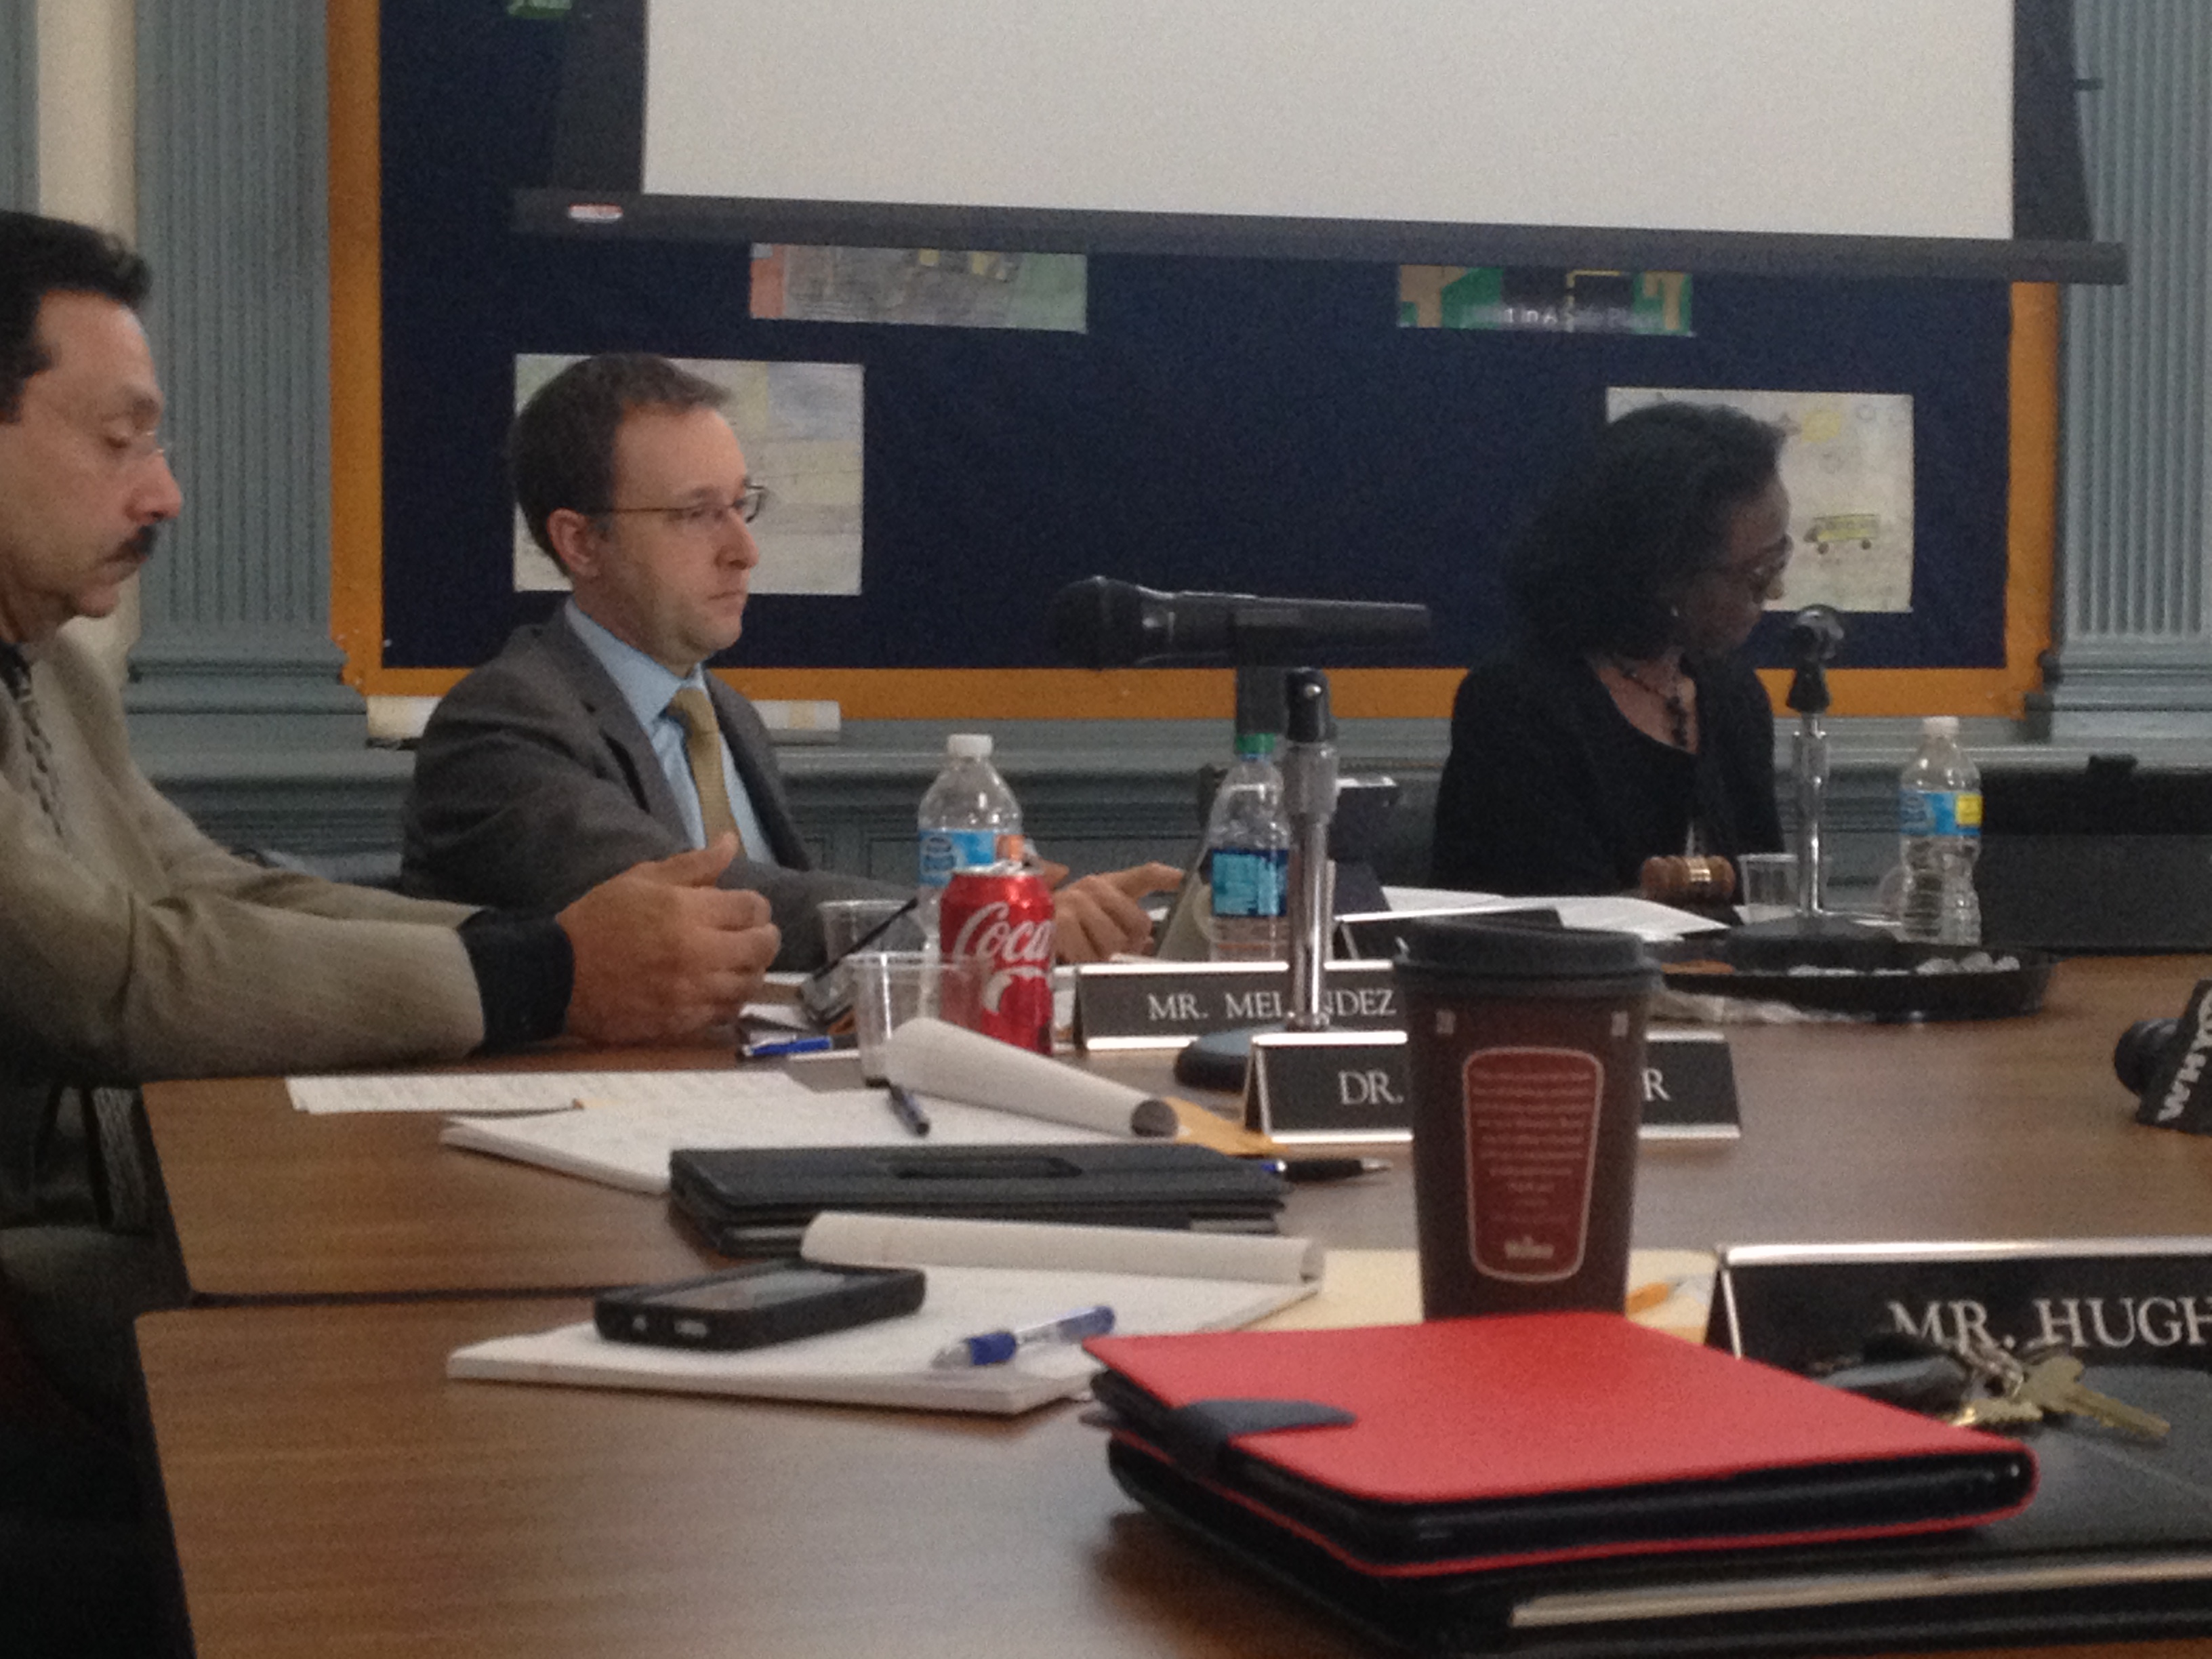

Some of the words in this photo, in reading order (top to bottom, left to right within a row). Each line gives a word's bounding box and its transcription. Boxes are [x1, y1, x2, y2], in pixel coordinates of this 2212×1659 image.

[952, 901, 1056, 969] Coca
[1147, 992, 1208, 1021] MR.
[1225, 988, 1397, 1019] MELNDEZ
[1338, 1069, 1404, 1105] DR.
[1886, 1298, 2015, 1354] MR.
